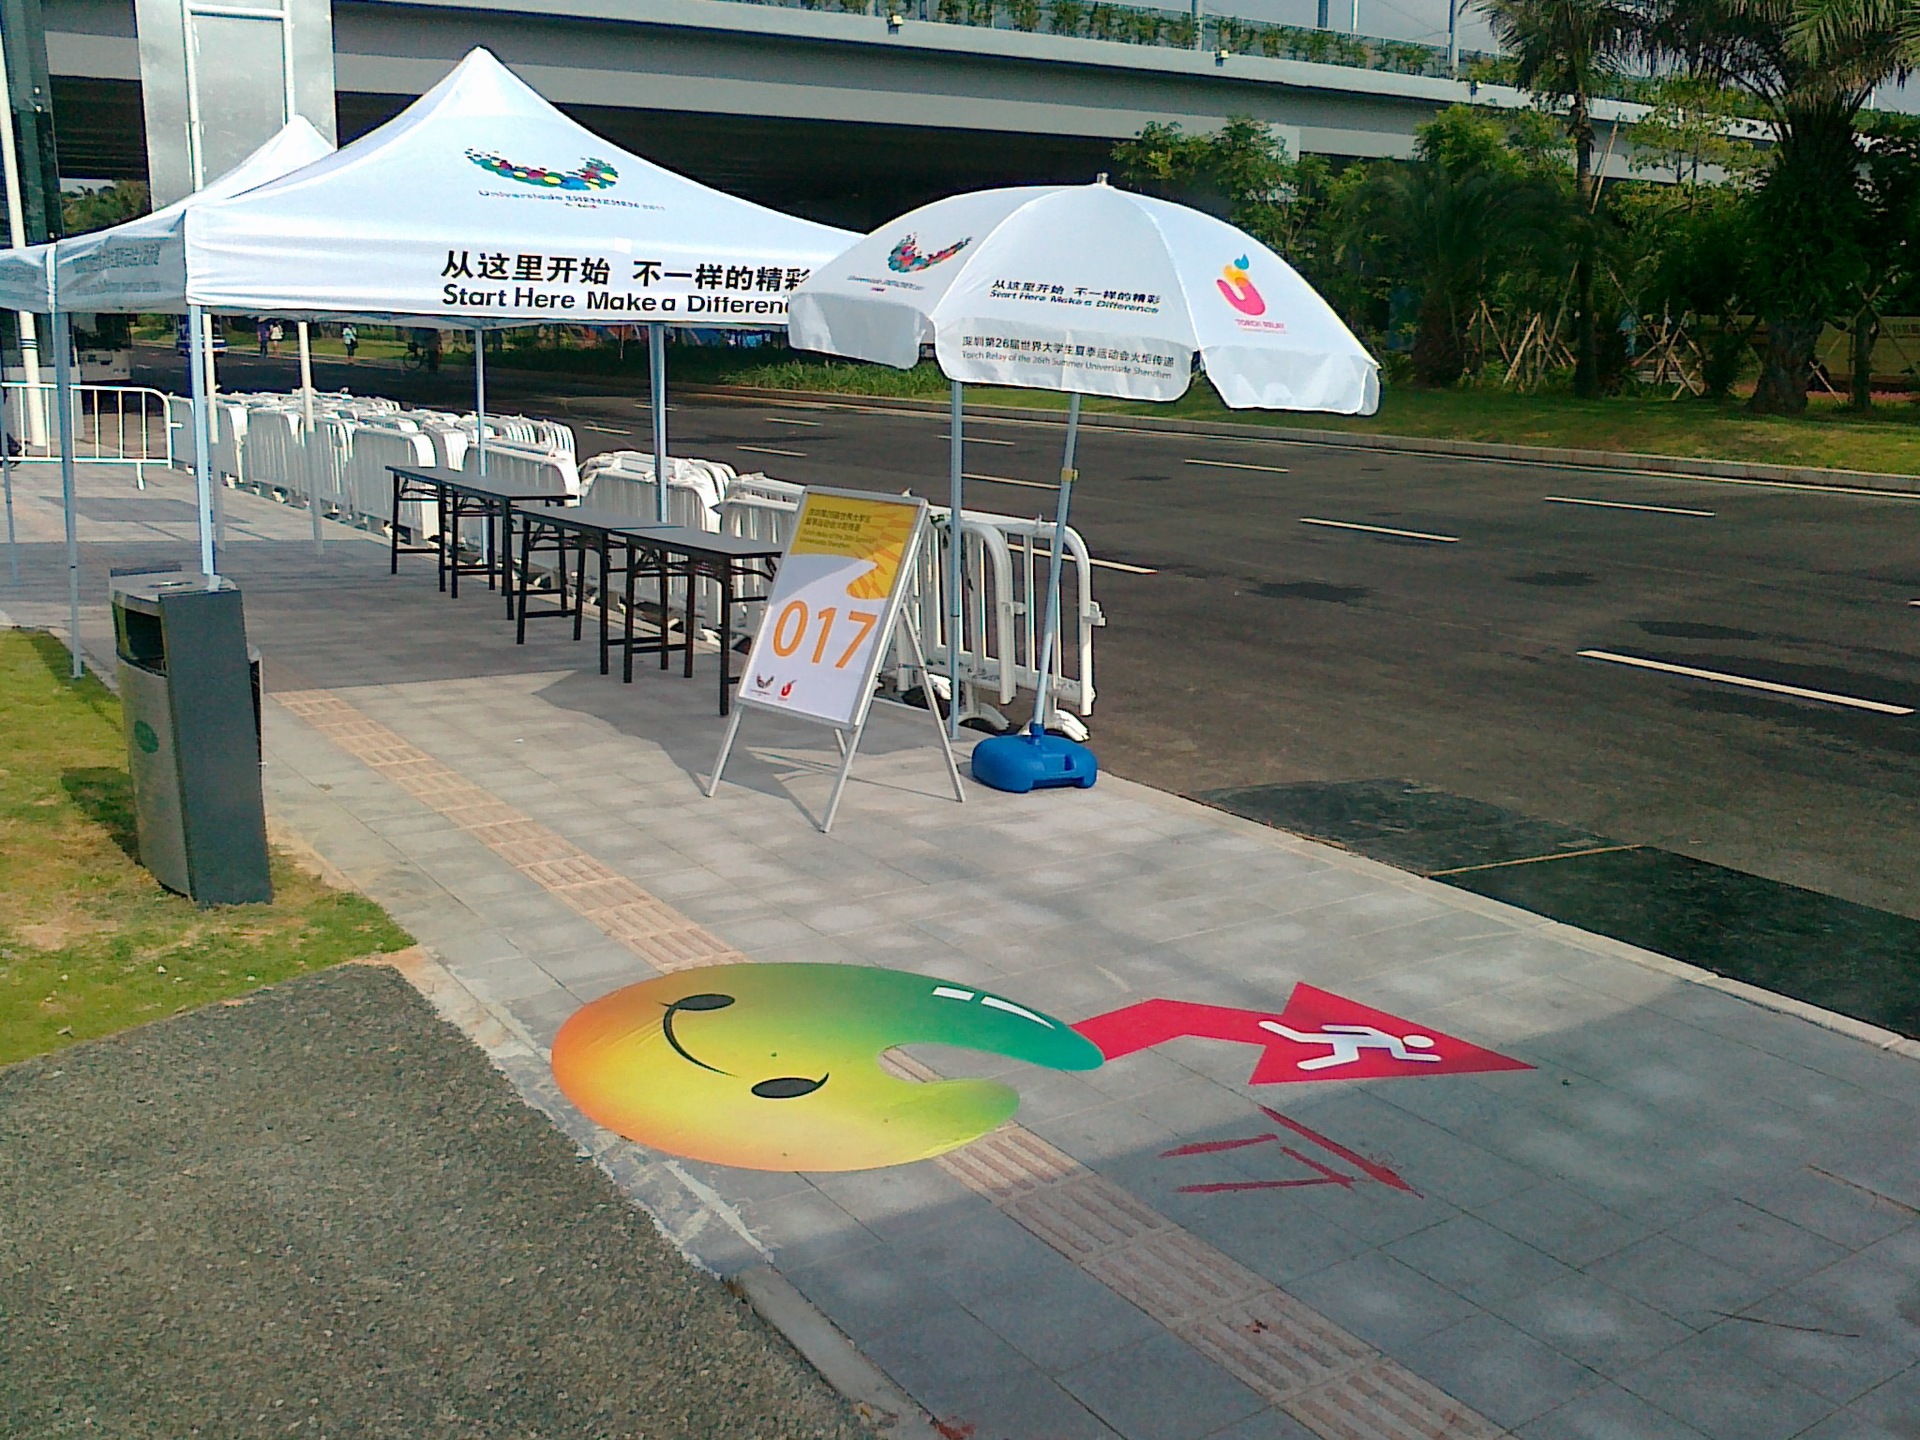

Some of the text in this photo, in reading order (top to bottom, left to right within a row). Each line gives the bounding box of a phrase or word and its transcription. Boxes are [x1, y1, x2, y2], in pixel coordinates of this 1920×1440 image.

[441, 250, 610, 285] 从这里开始
[632, 260, 811, 292] 不一样的精彩
[442, 283, 507, 307] Start
[514, 286, 576, 309] Here
[586, 291, 657, 312] Make
[687, 294, 789, 315] Differen
[989, 289, 1018, 300] Start
[1019, 292, 1047, 302] Here
[1050, 295, 1083, 306] Make
[1096, 300, 1160, 314] Difference
[991, 279, 1161, 305] 从这里开始 不一样的精彩
[961, 350, 1172, 379] Torch Relay of the 26th Summer Universiade Shenzhen
[773, 599, 878, 669] 017
